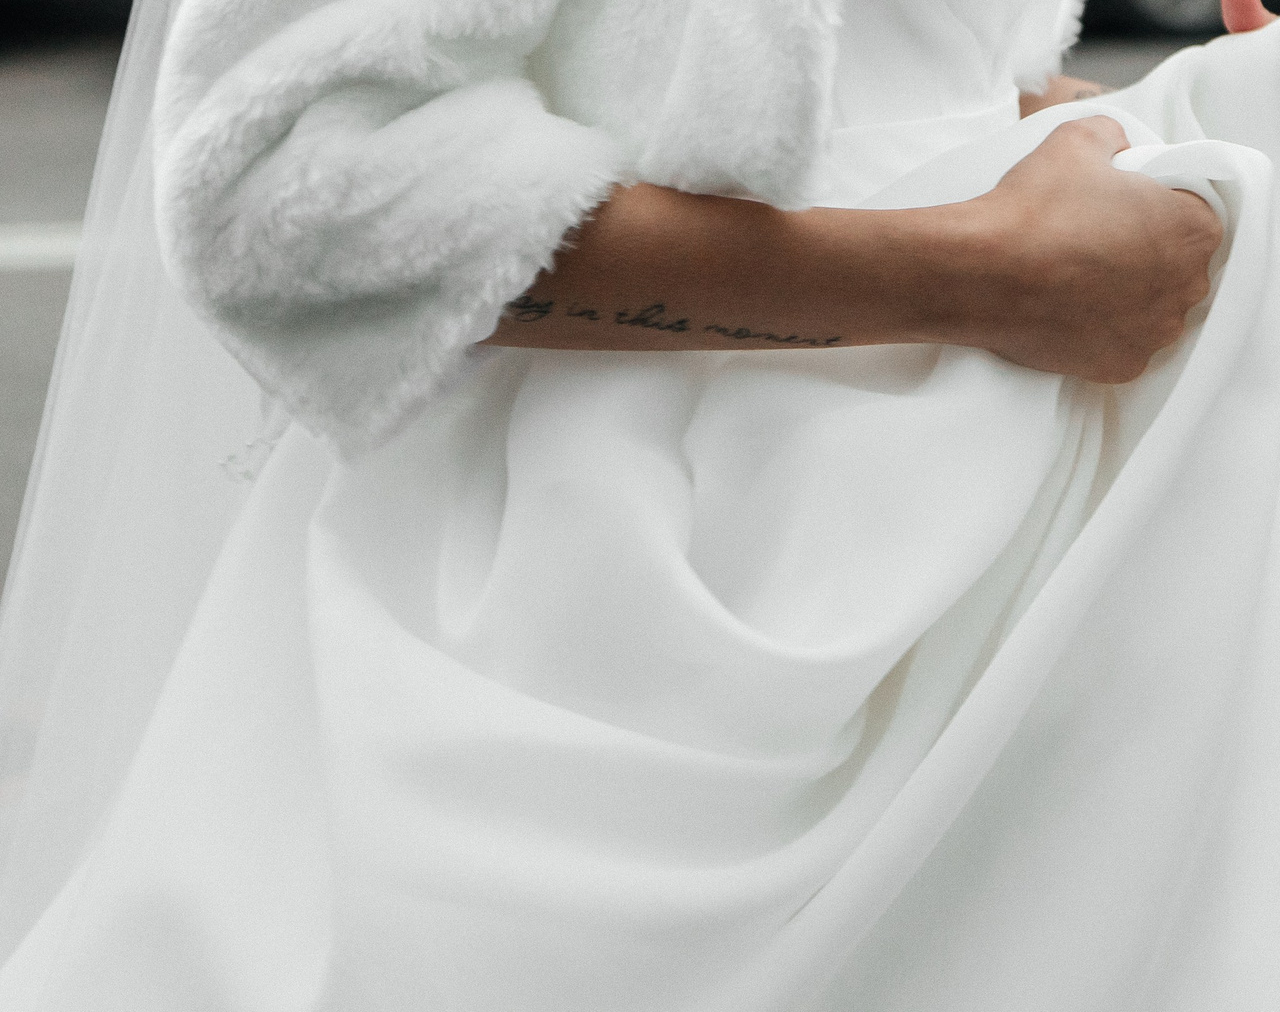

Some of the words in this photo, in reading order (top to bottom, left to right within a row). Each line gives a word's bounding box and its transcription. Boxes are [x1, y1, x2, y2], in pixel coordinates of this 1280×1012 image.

[566, 301, 600, 321] in
[614, 302, 691, 332] this
[703, 323, 842, 346] moment
